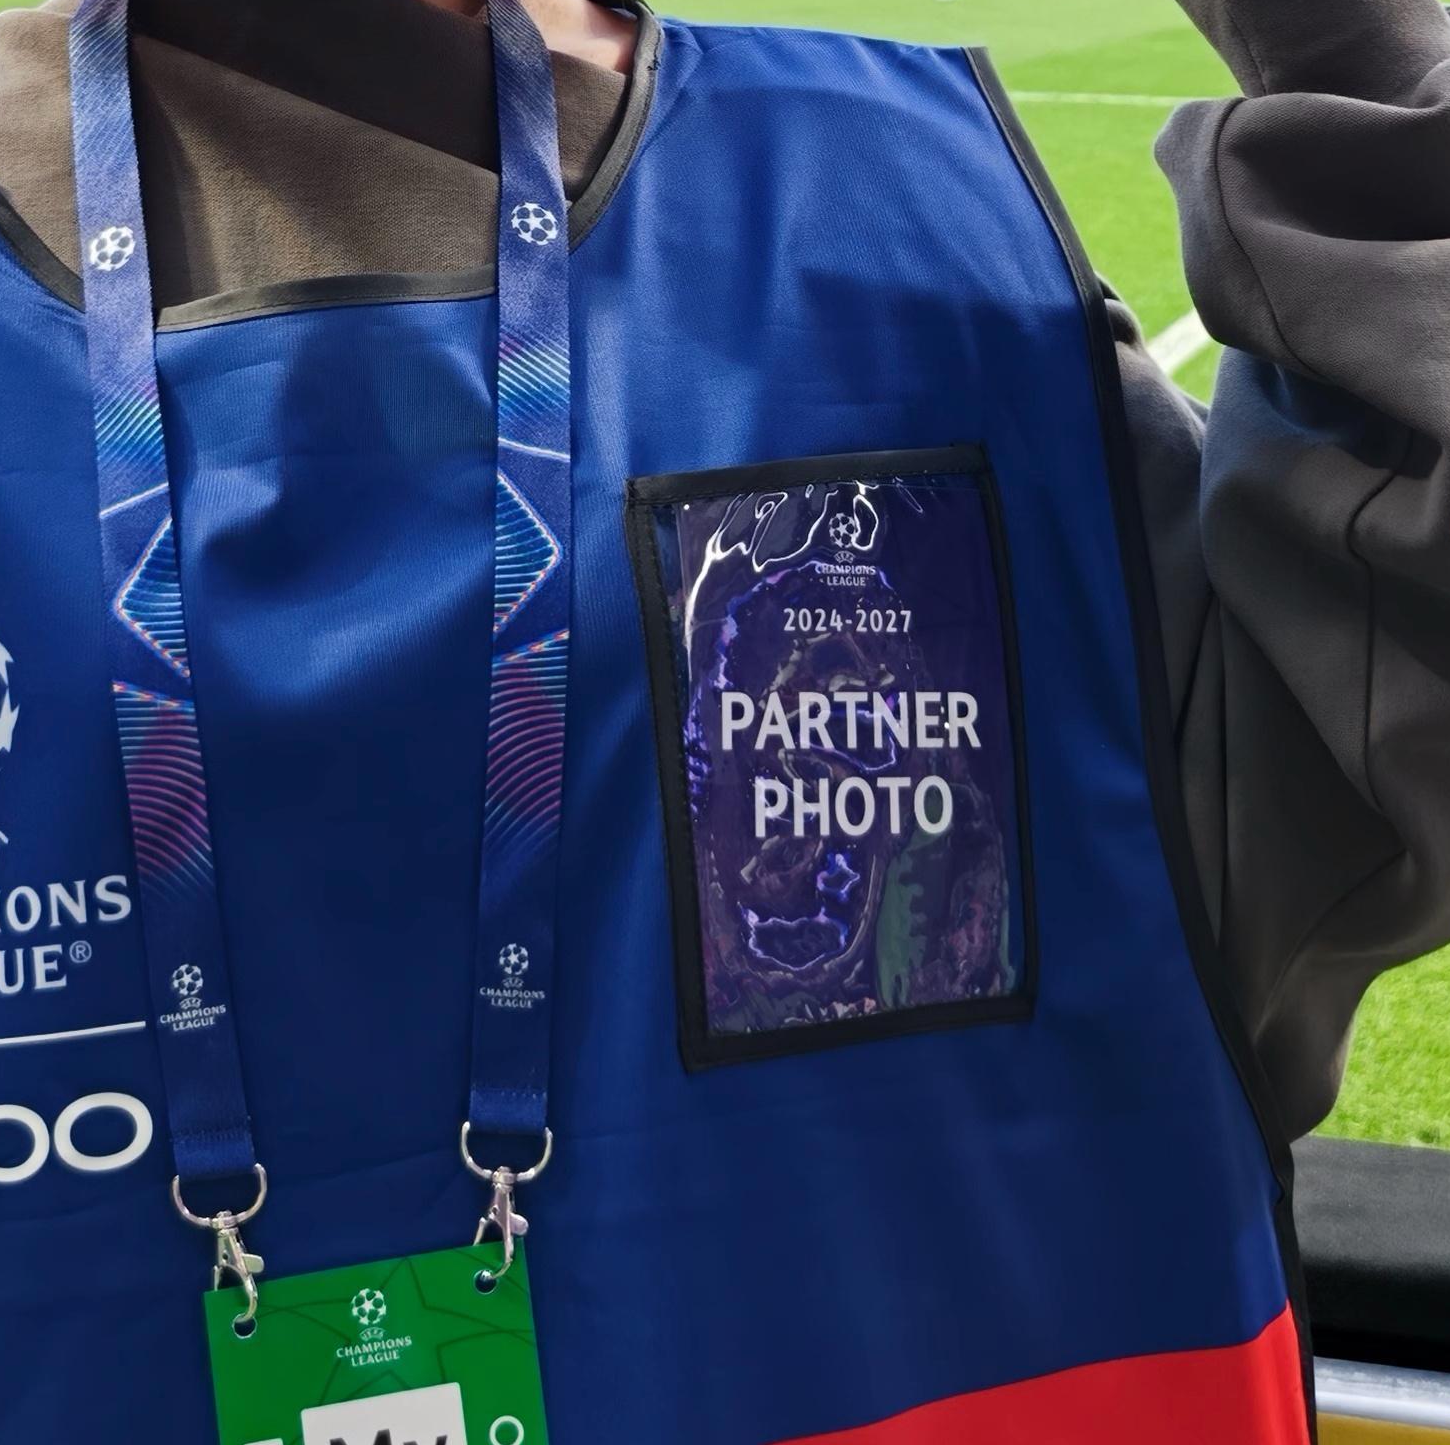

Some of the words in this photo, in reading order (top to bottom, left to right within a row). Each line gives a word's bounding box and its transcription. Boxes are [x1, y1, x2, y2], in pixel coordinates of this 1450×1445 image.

[814, 565, 876, 576] CHAMPIONS
[826, 575, 867, 587] LEAGUE
[783, 607, 911, 633] 2024-2027
[721, 690, 982, 752] PARTNER
[754, 774, 953, 839] PHOTO
[478, 986, 546, 1000] CHAMPIONS
[159, 1004, 227, 1024] CHAMPIONS
[336, 1335, 412, 1358] CHAMPIONS
[351, 1349, 400, 1367] LEAGUE
